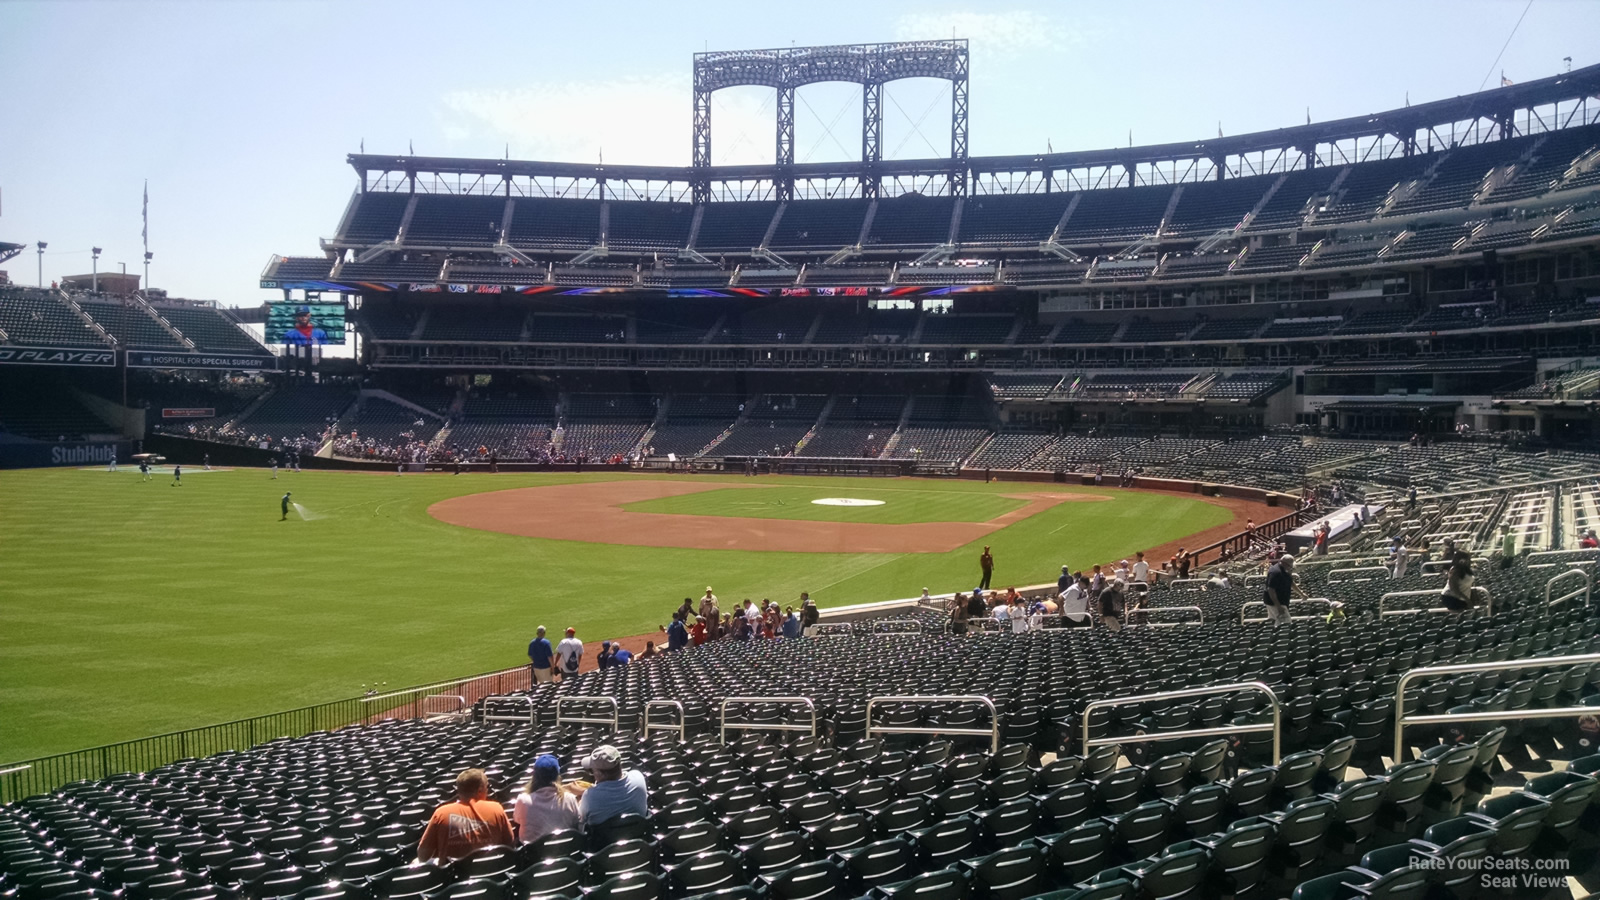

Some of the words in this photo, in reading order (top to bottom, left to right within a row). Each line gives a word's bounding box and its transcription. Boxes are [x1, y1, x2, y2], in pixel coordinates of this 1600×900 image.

[17, 351, 113, 362] PLAYER
[154, 356, 186, 364] HOSPITAL
[187, 357, 200, 365] FOR
[202, 358, 231, 366] SPECIAL
[232, 359, 263, 367] SURGERY
